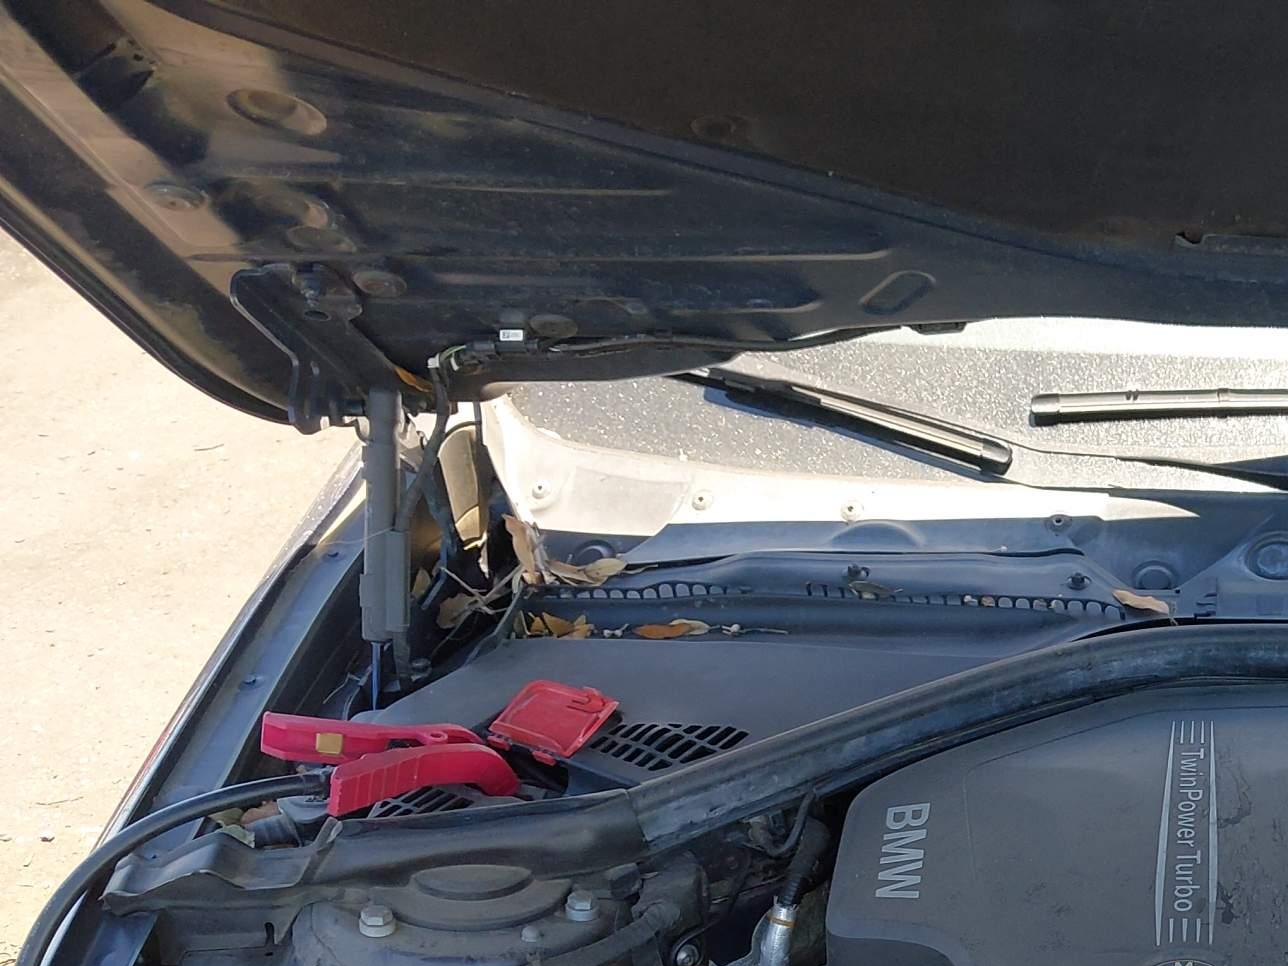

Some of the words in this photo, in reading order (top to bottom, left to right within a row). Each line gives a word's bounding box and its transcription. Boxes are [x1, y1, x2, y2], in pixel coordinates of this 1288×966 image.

[1176, 748, 1205, 847] TwinPower
[875, 802, 930, 899] BMW
[1173, 849, 1201, 913] Turbo
